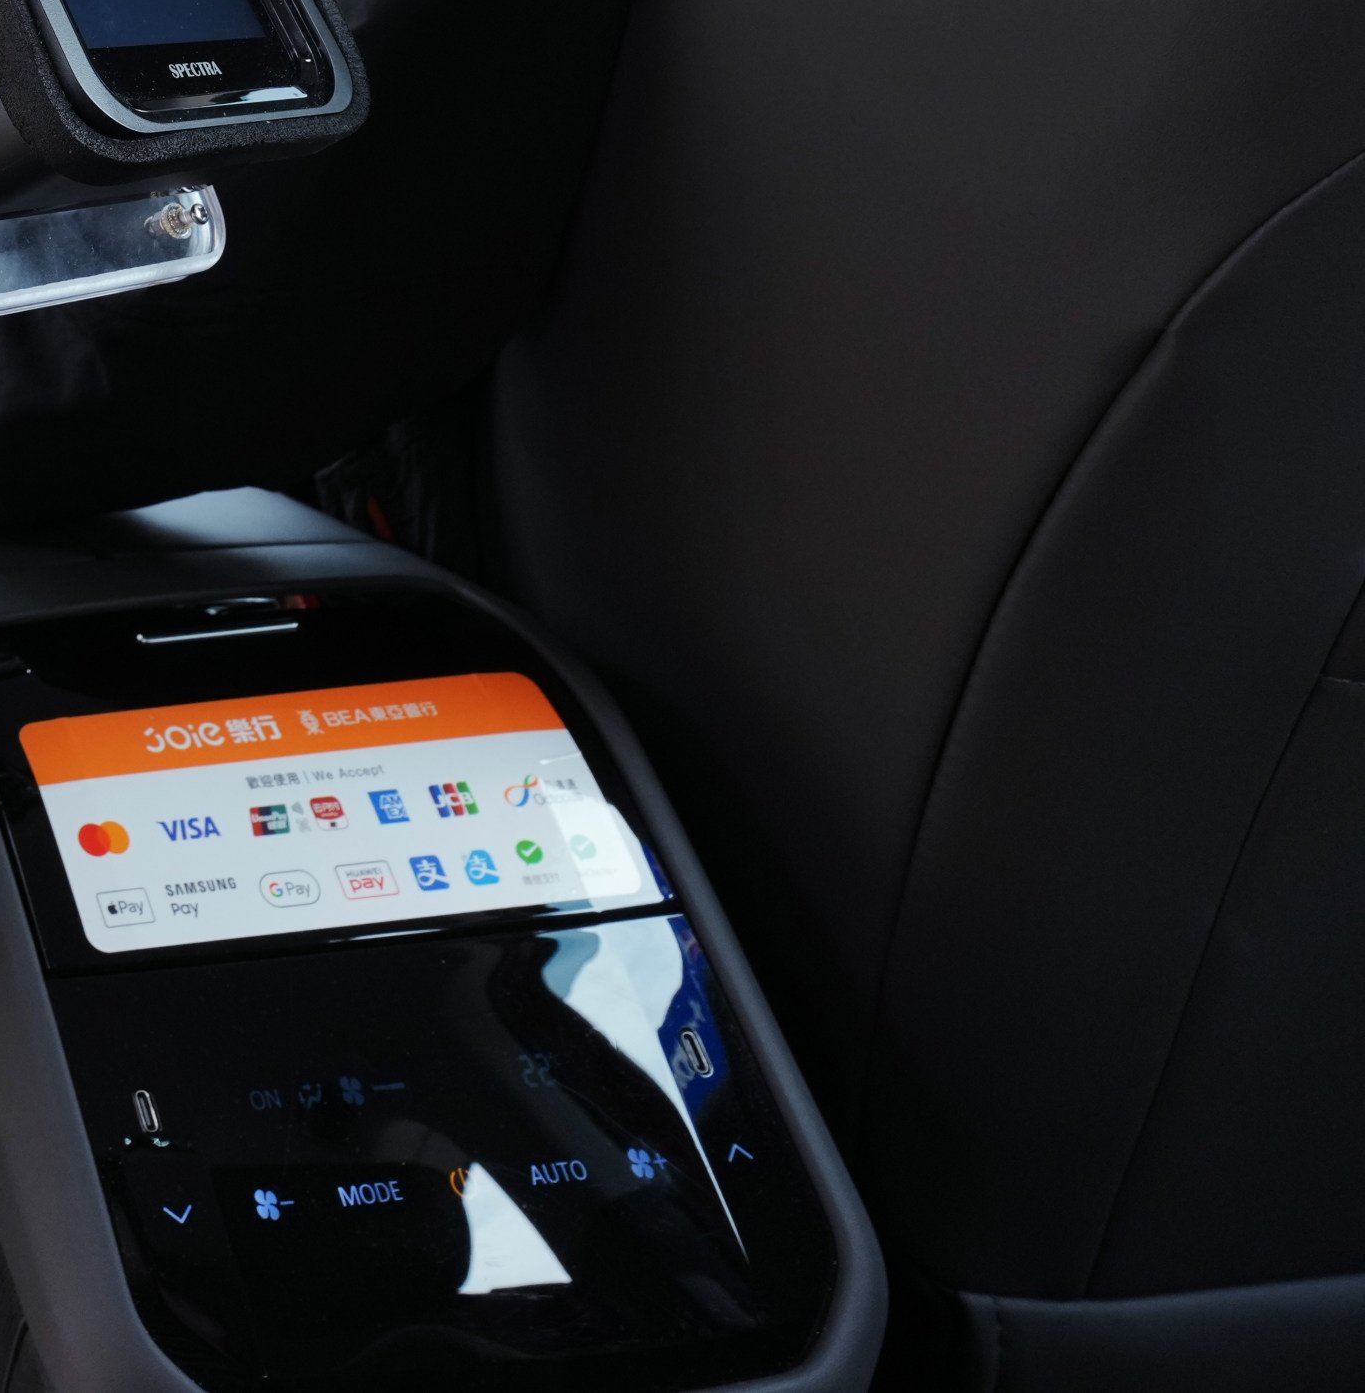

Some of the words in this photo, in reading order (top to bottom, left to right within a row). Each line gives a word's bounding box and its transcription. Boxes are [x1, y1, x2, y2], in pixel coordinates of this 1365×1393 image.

[168, 61, 223, 79] SPECTRA
[225, 715, 282, 744] 樂行
[312, 770, 333, 781] We
[339, 765, 385, 778] Accept
[436, 791, 475, 807] JCB
[157, 816, 222, 842] VISA
[345, 867, 381, 878] HUAWEI
[165, 877, 238, 897] SAMSUNG
[286, 881, 311, 897] Pay
[350, 872, 385, 893] pay
[118, 900, 144, 915] Pay
[530, 1159, 589, 1186] AUTO
[337, 1179, 403, 1208] MODE
